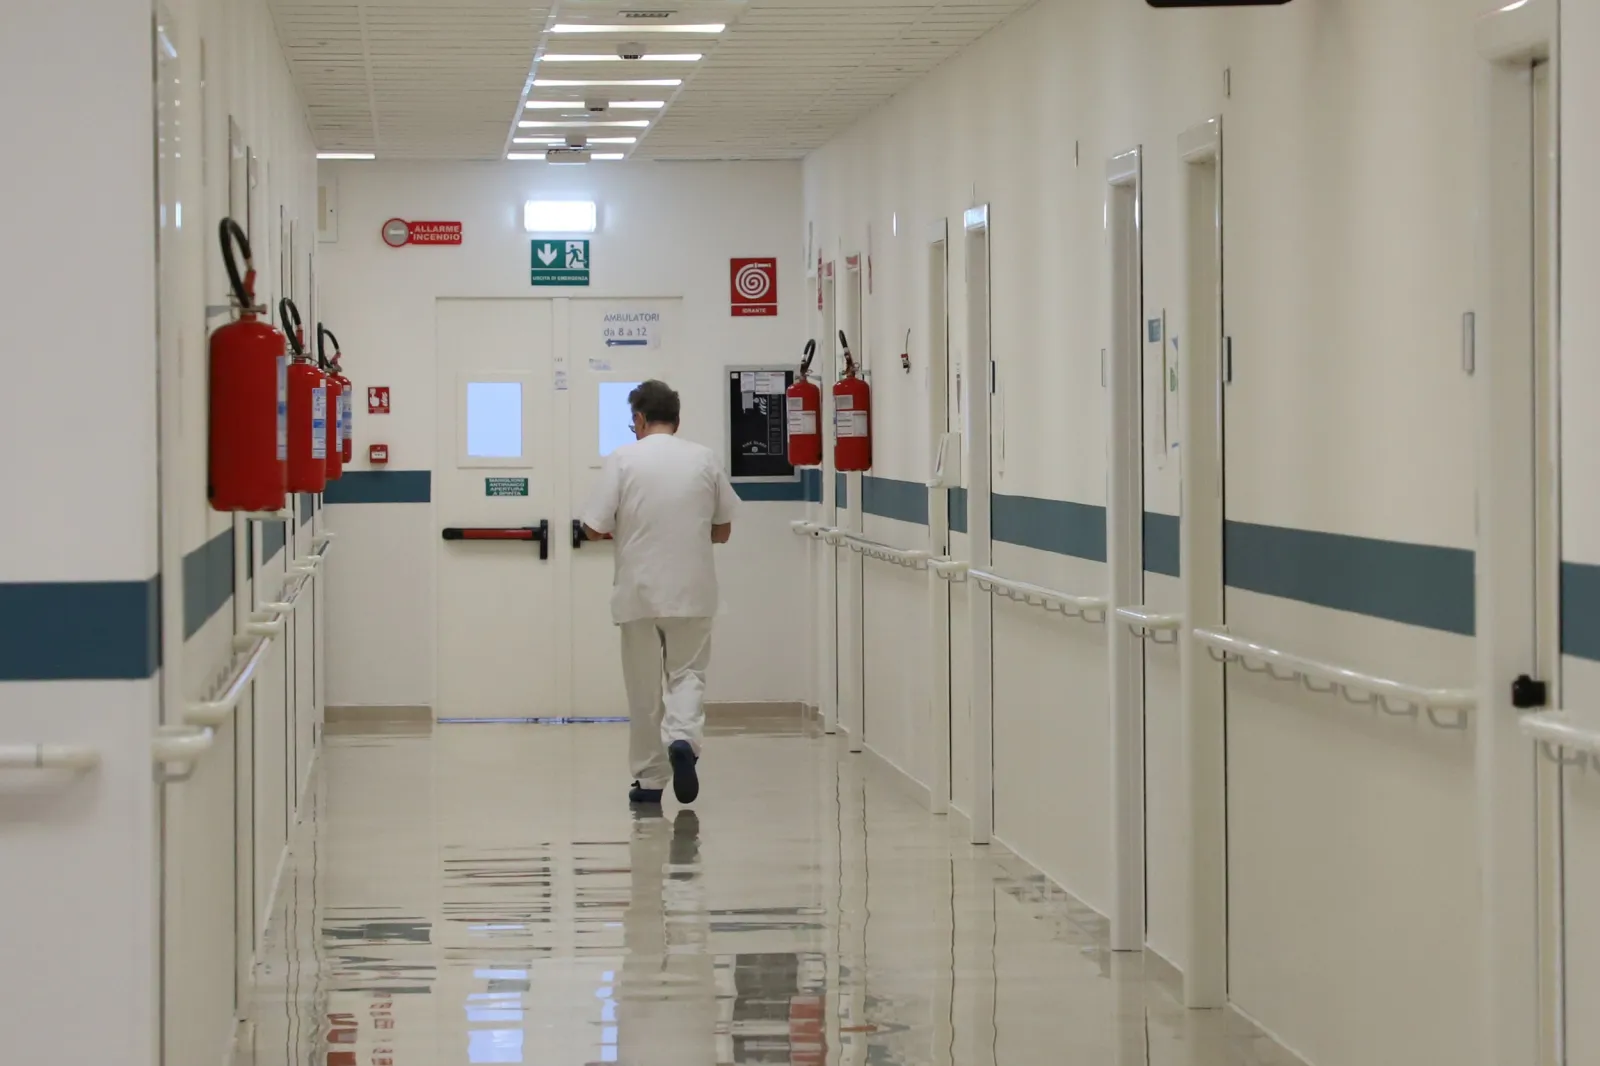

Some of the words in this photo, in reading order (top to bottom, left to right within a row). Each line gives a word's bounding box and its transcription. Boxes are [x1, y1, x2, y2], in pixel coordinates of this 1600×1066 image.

[414, 225, 460, 233] ALLARME
[413, 233, 461, 241] INCENDIO
[603, 313, 660, 322] AMBULATORI
[603, 327, 615, 337] da
[618, 327, 624, 337] 8
[627, 329, 633, 337] a
[636, 327, 648, 337] 12
